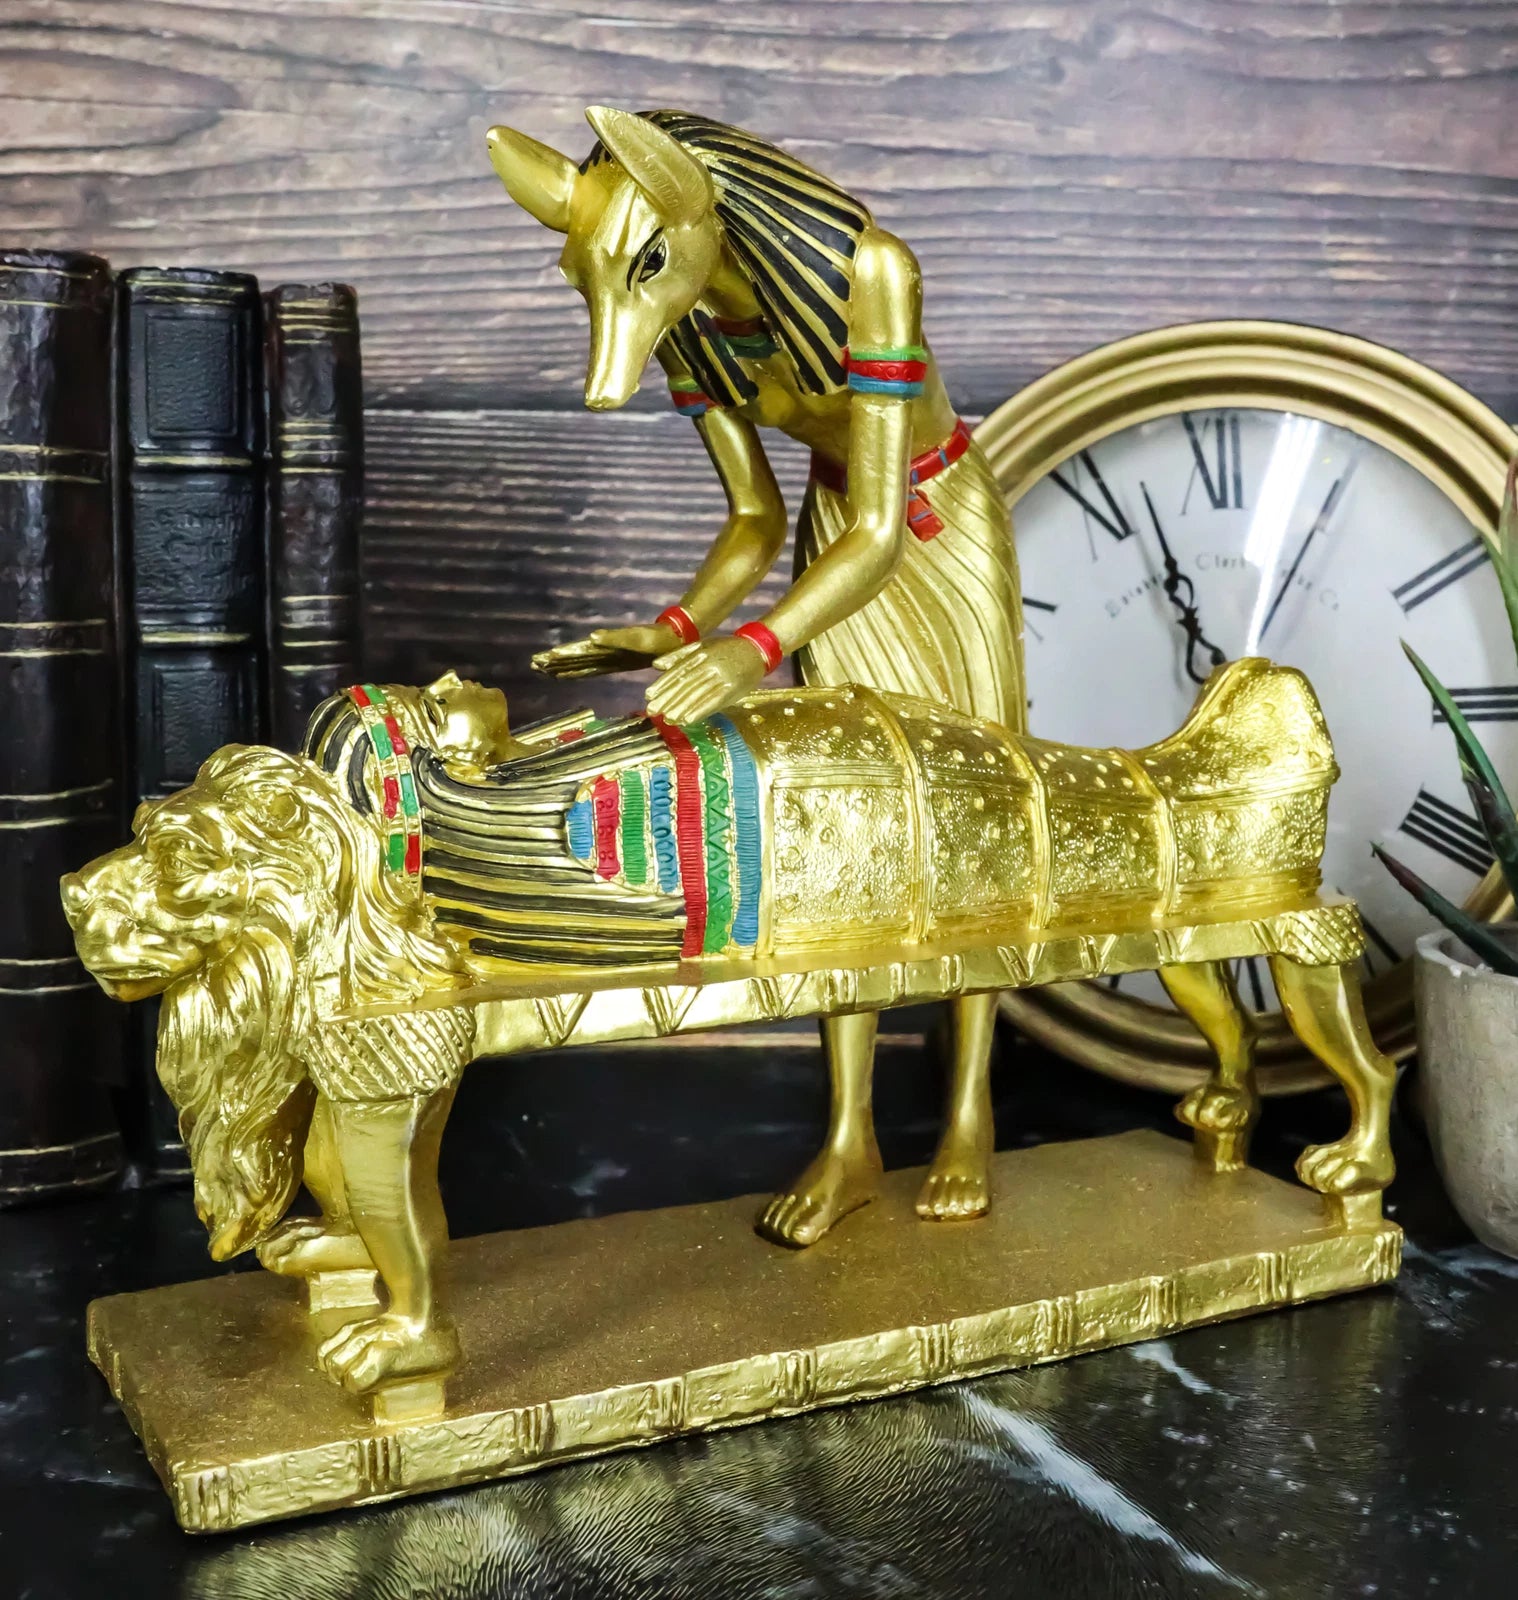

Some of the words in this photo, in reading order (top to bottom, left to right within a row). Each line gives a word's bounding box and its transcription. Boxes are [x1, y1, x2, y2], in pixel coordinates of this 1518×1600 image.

[1049, 449, 1136, 562] XI
[1181, 411, 1243, 516] XII
[1387, 535, 1491, 618] II
[1432, 686, 1518, 728] III
